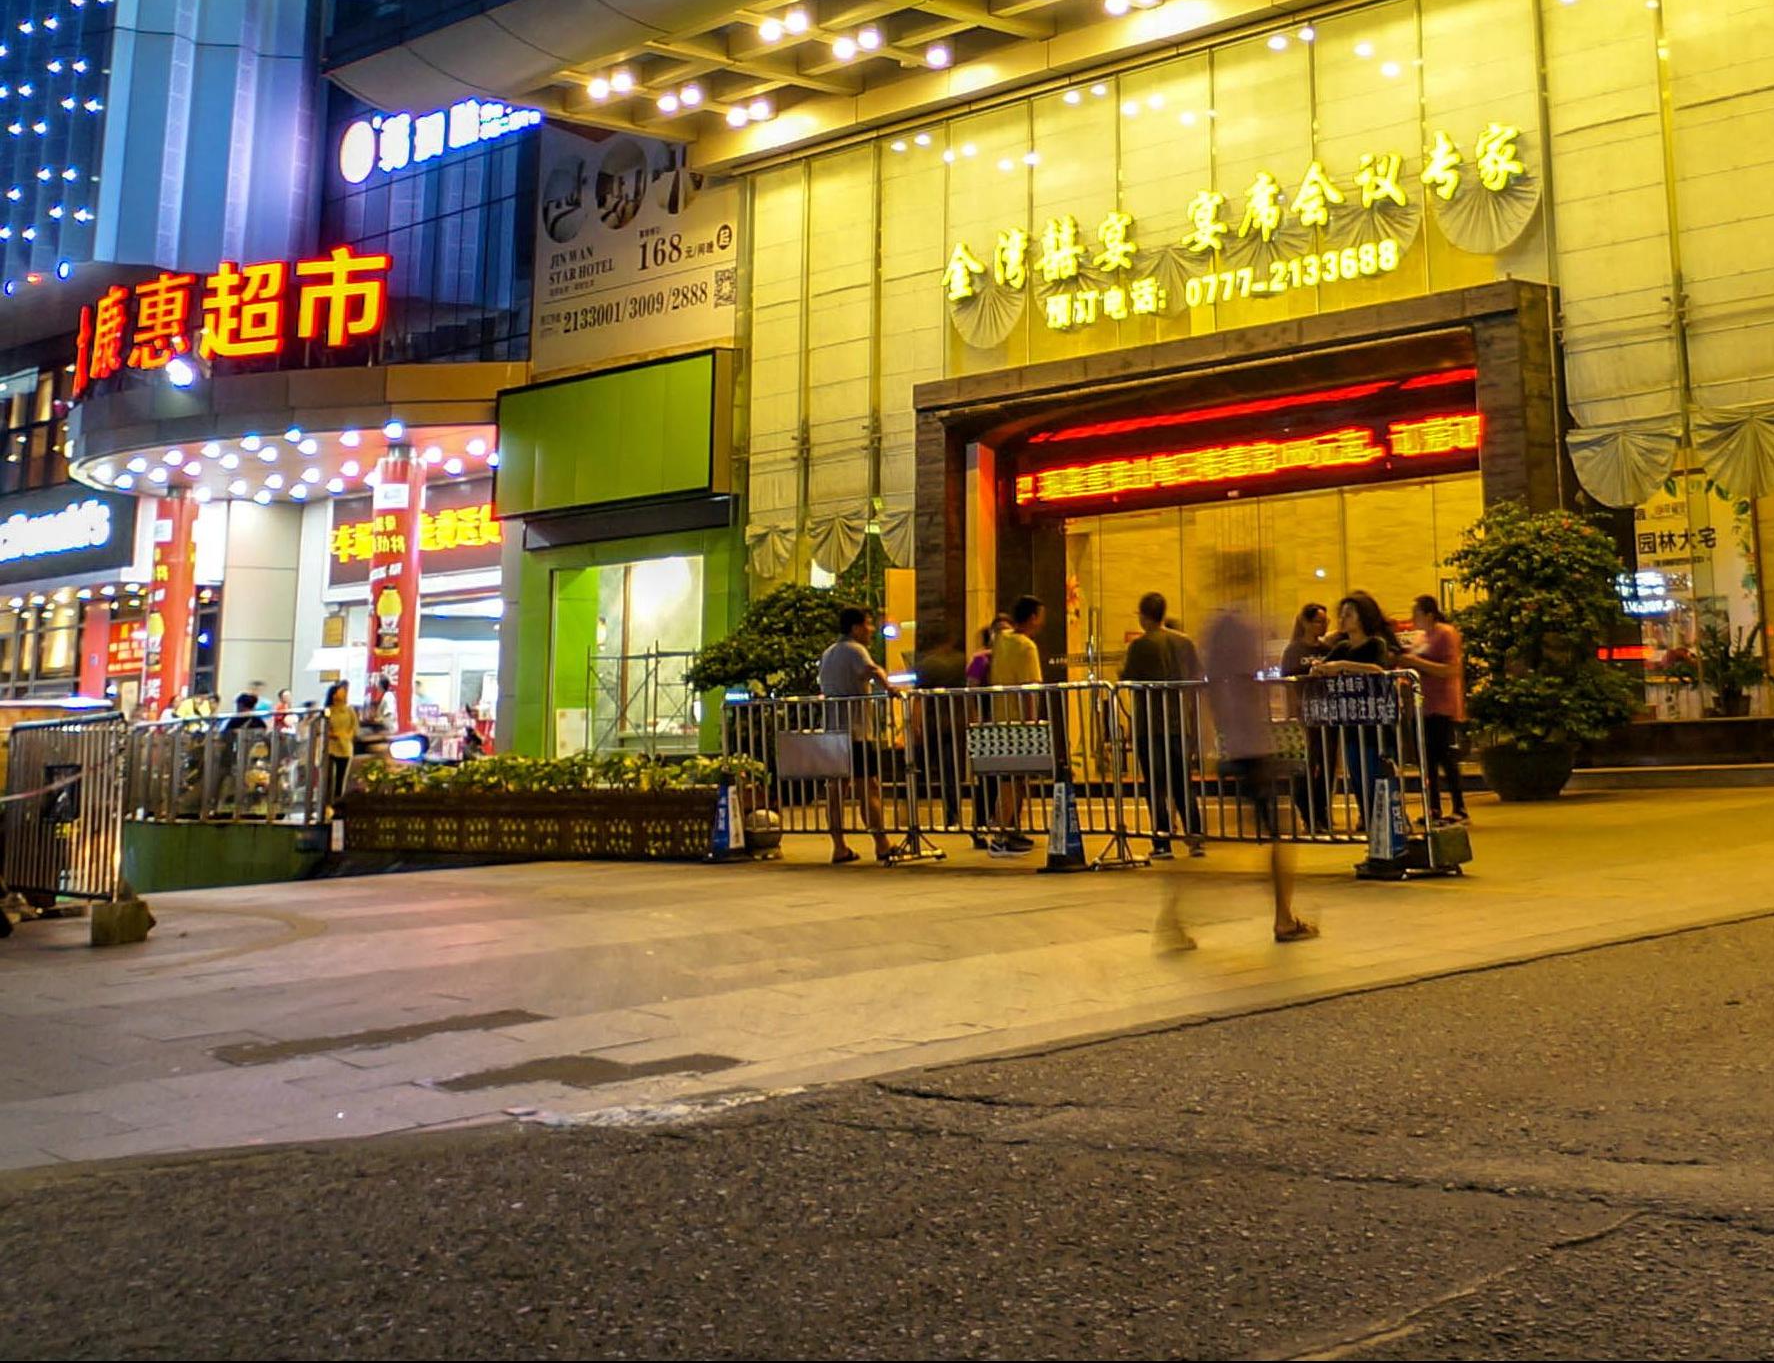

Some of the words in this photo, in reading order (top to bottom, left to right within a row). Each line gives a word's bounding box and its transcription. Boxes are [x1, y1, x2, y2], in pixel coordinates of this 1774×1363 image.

[1181, 122, 1525, 253] 宴席会议专家
[549, 266, 577, 286] STAR
[577, 258, 615, 279] HOTEL
[638, 232, 682, 271] 168
[1184, 238, 1401, 309] 0777-2133688
